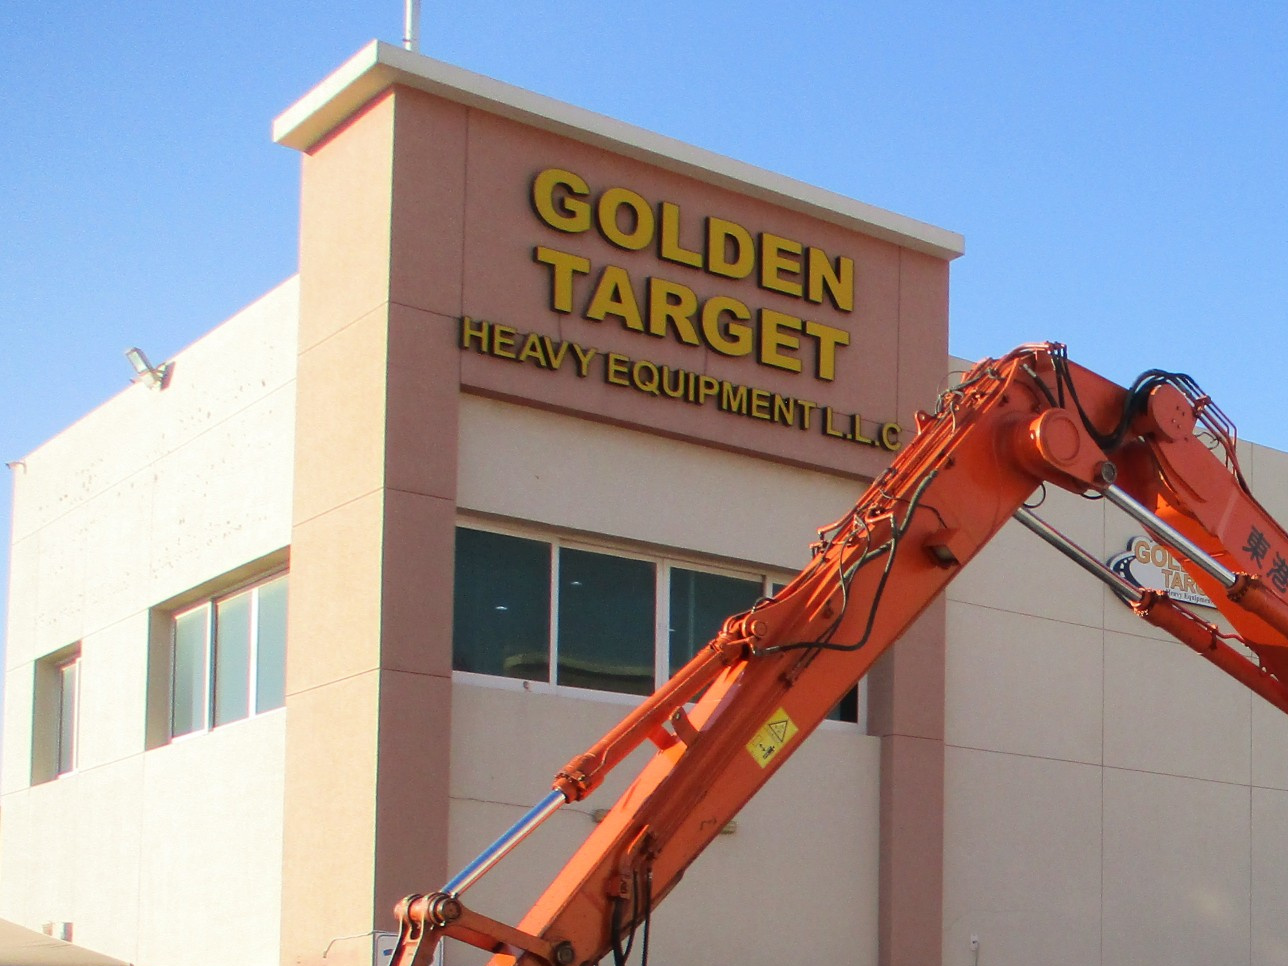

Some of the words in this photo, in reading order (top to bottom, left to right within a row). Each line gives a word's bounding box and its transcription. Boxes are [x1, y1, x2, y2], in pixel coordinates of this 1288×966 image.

[532, 167, 855, 312] GOLDEN
[534, 246, 851, 382] TARGET
[461, 316, 597, 378] HEAVY
[607, 353, 817, 431] EQUIPMENT
[823, 406, 902, 451] L.L.C
[1134, 540, 1187, 573] GOL
